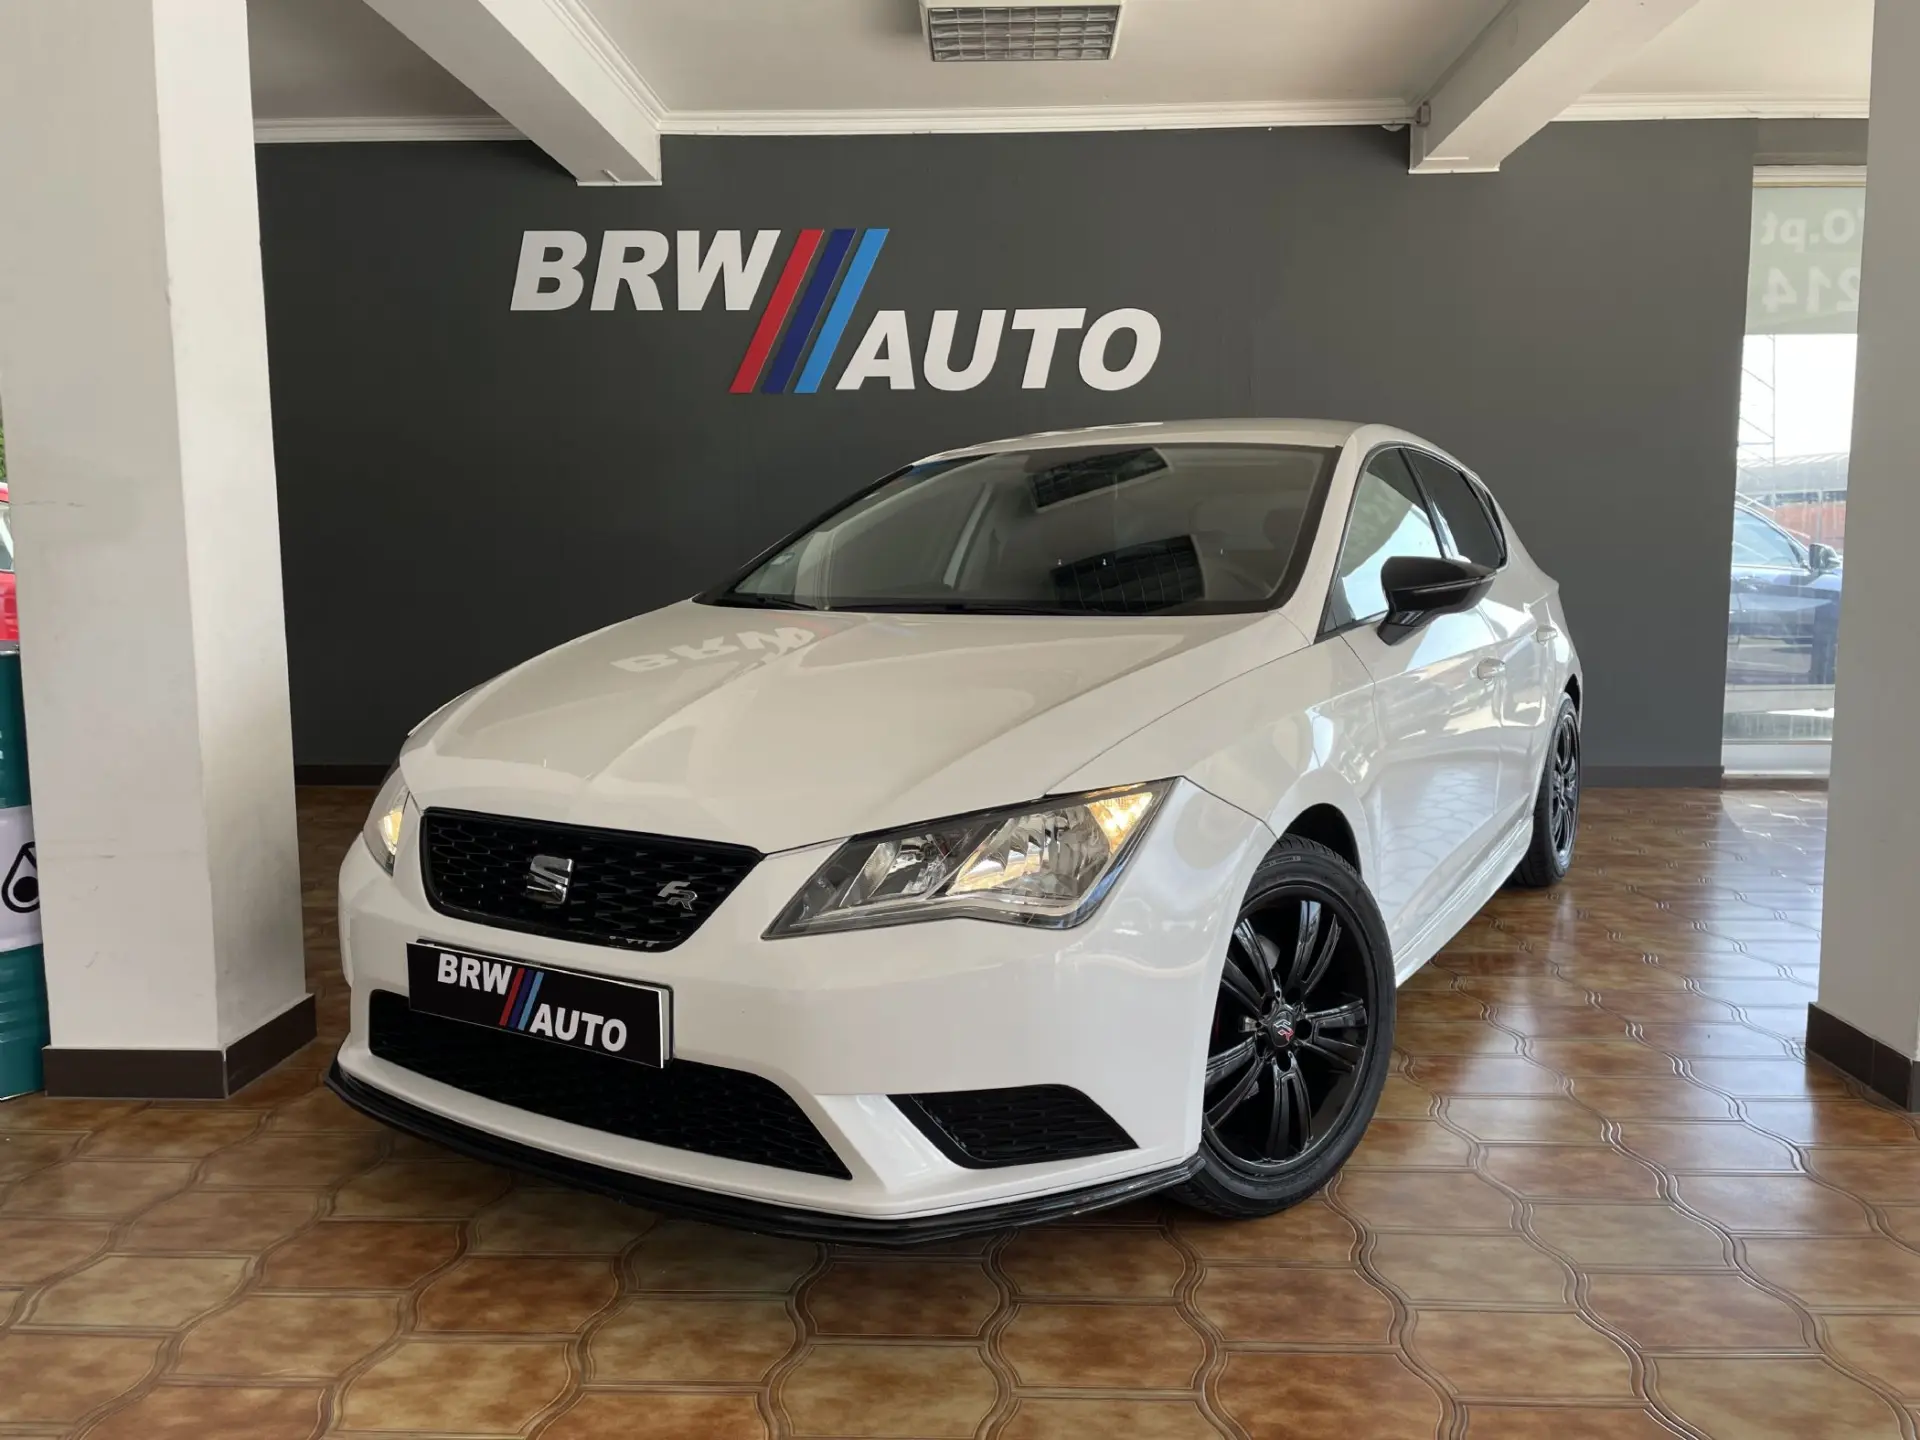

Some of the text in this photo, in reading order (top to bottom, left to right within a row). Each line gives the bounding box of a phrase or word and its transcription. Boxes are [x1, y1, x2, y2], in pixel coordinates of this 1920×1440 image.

[510, 229, 781, 311] BRW
[835, 308, 1161, 391] AUTO
[657, 880, 698, 911] FR
[437, 953, 512, 995] BRW
[529, 1003, 627, 1052] AUTO
